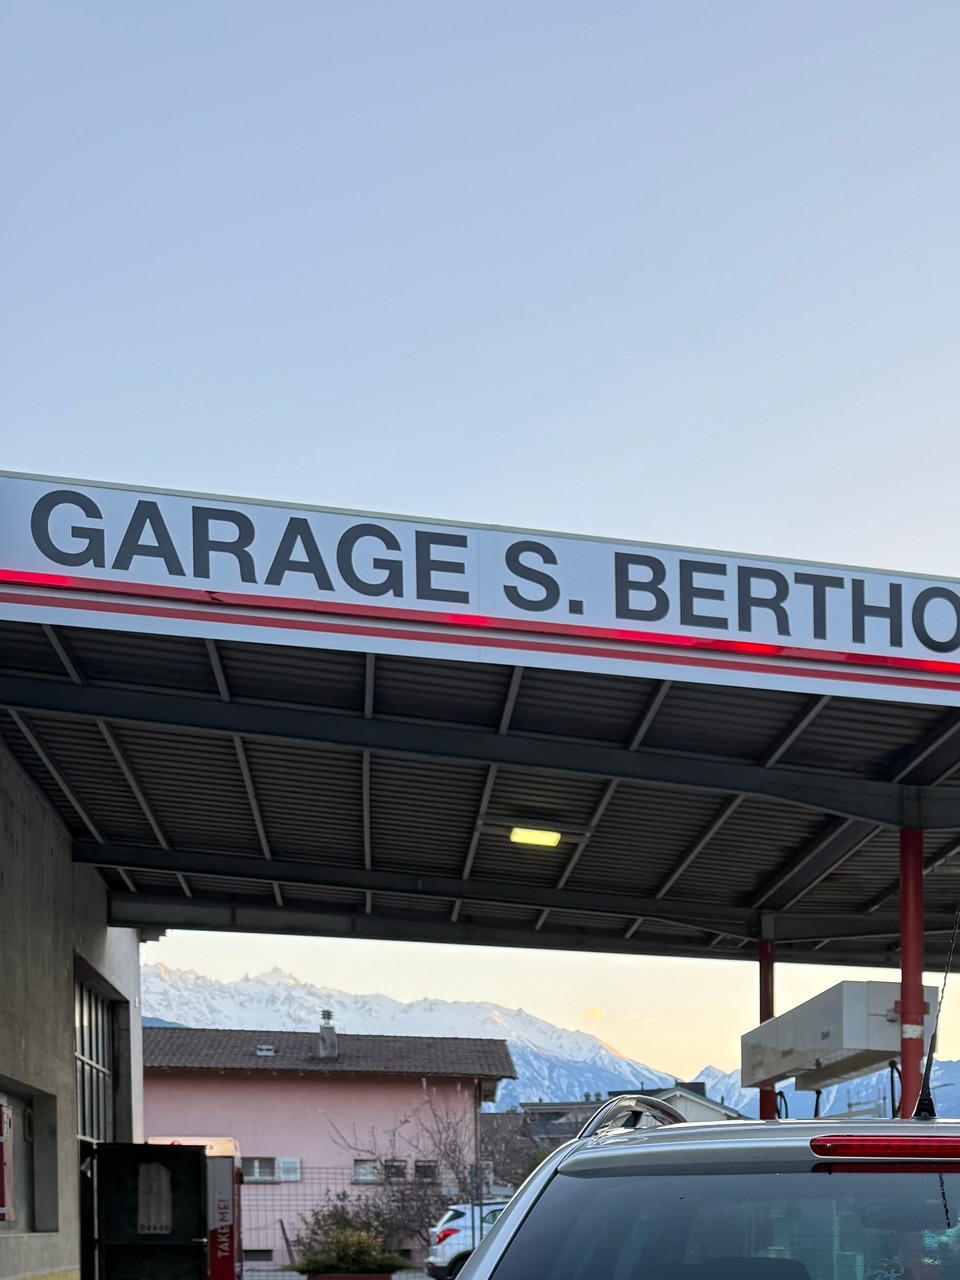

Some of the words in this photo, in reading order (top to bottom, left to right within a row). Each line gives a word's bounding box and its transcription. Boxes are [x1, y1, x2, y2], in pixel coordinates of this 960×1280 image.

[30, 489, 471, 605] GARAGE
[503, 539, 586, 616] S.
[217, 1226, 230, 1259] TAKE
